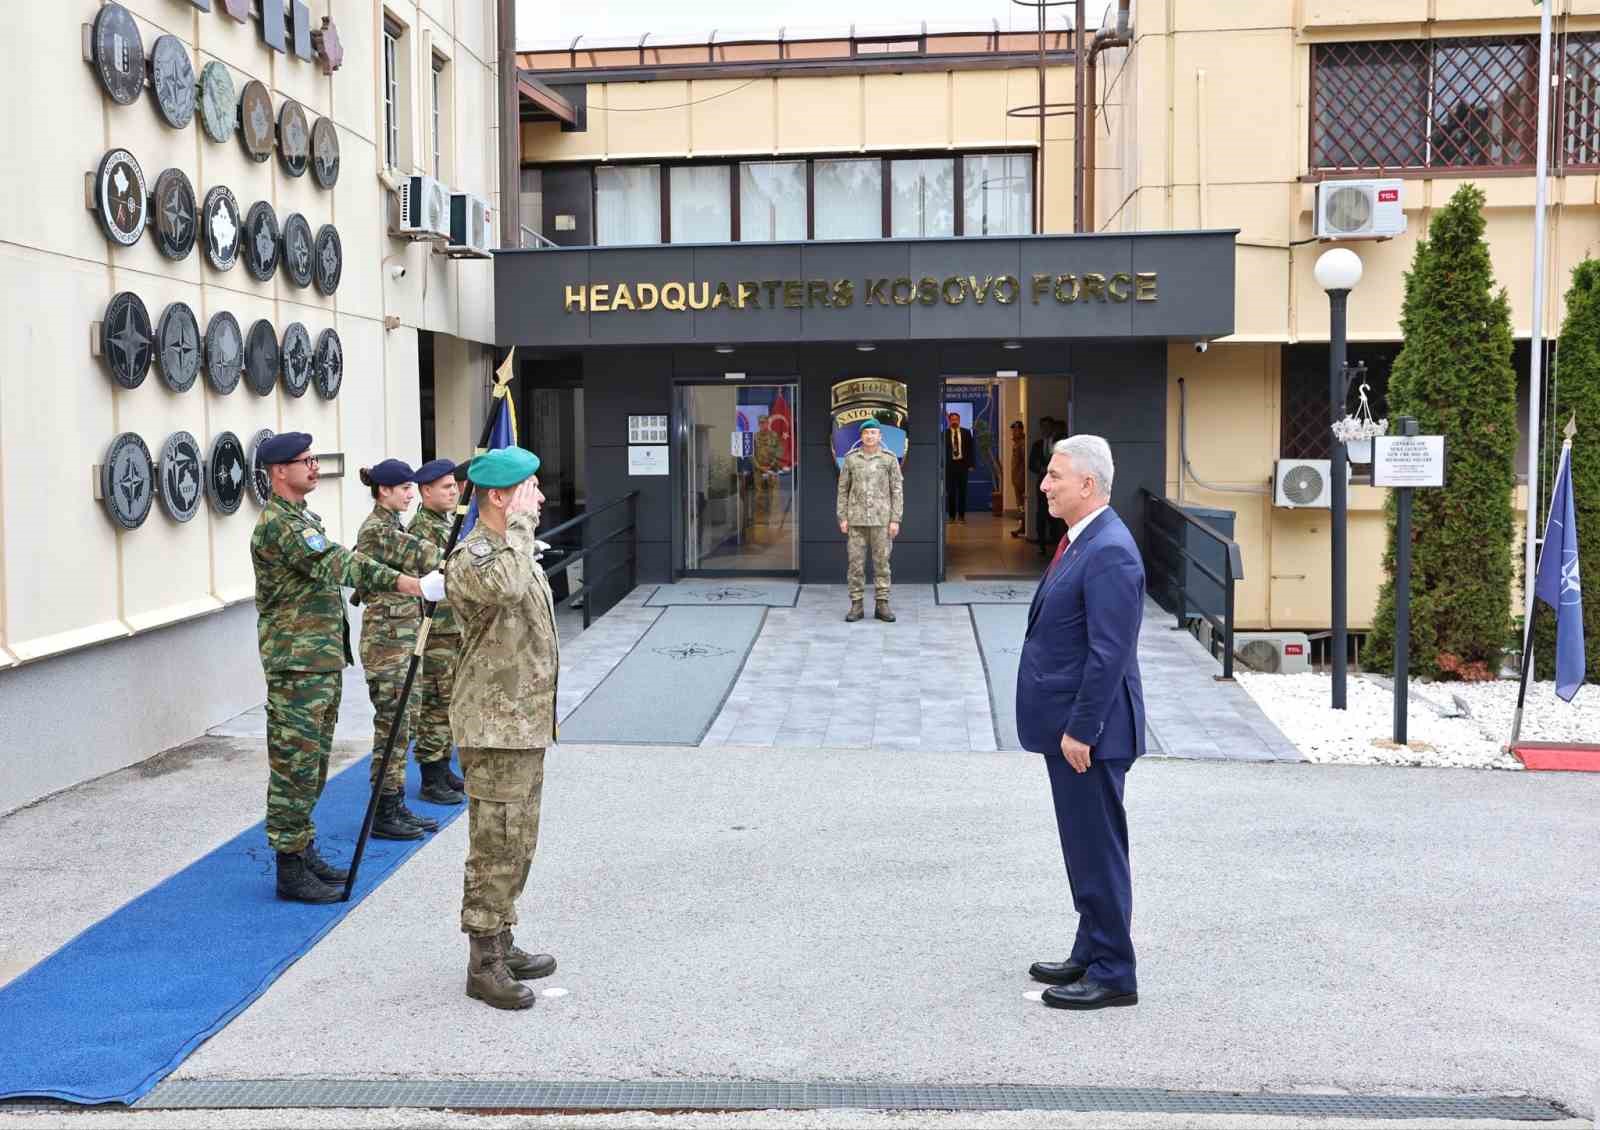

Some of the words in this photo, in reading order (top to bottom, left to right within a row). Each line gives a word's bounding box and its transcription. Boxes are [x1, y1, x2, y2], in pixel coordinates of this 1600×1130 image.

[1380, 191, 1396, 199] TCL
[564, 279, 854, 312] HEADQUARTERS
[864, 274, 1021, 305] KOSOVO
[1031, 271, 1158, 305] FORCE
